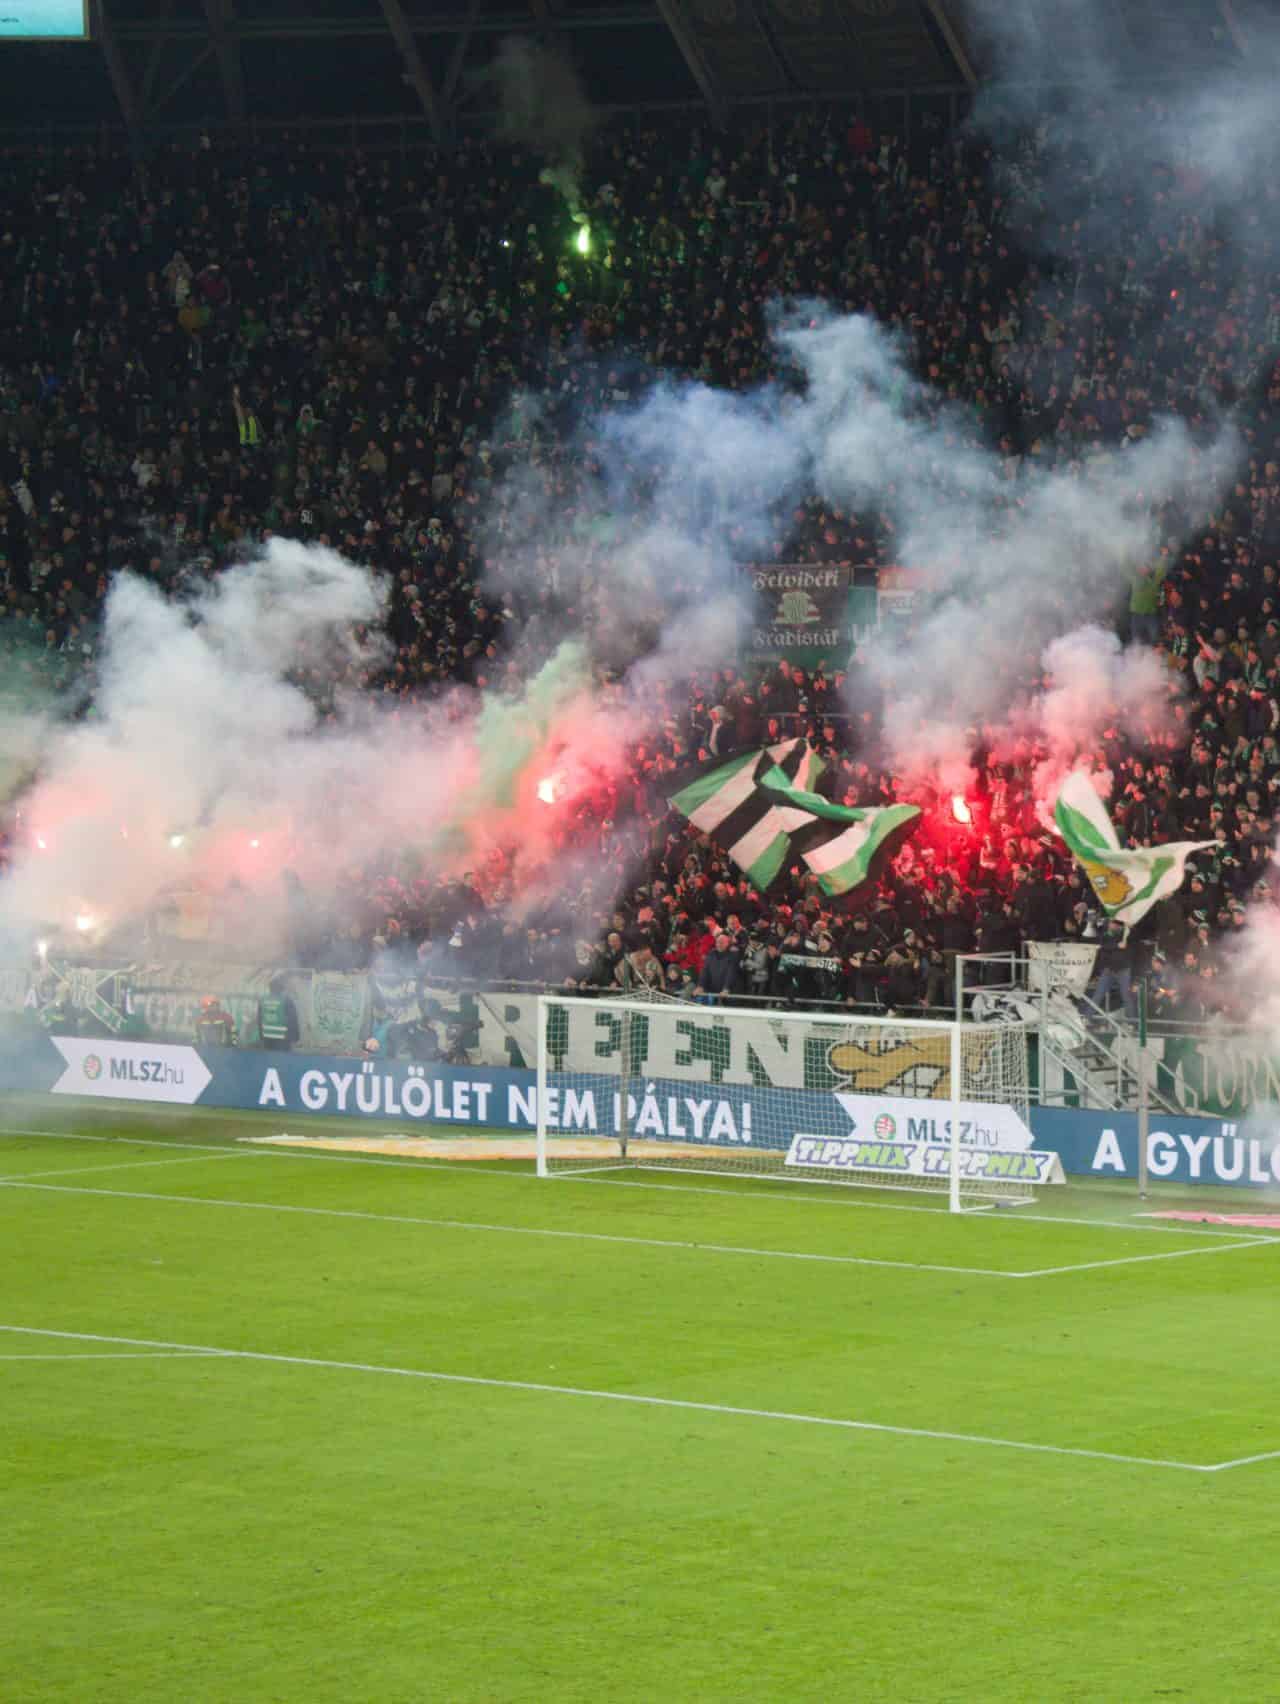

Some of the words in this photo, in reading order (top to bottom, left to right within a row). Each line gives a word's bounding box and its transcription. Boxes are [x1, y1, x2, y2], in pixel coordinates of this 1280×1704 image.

[110, 1056, 184, 1085] MLSZ.hu
[259, 1067, 286, 1107] A
[507, 1084, 597, 1130] NEM
[614, 1082, 752, 1144] PÁLYA!
[1092, 1129, 1125, 1173] A
